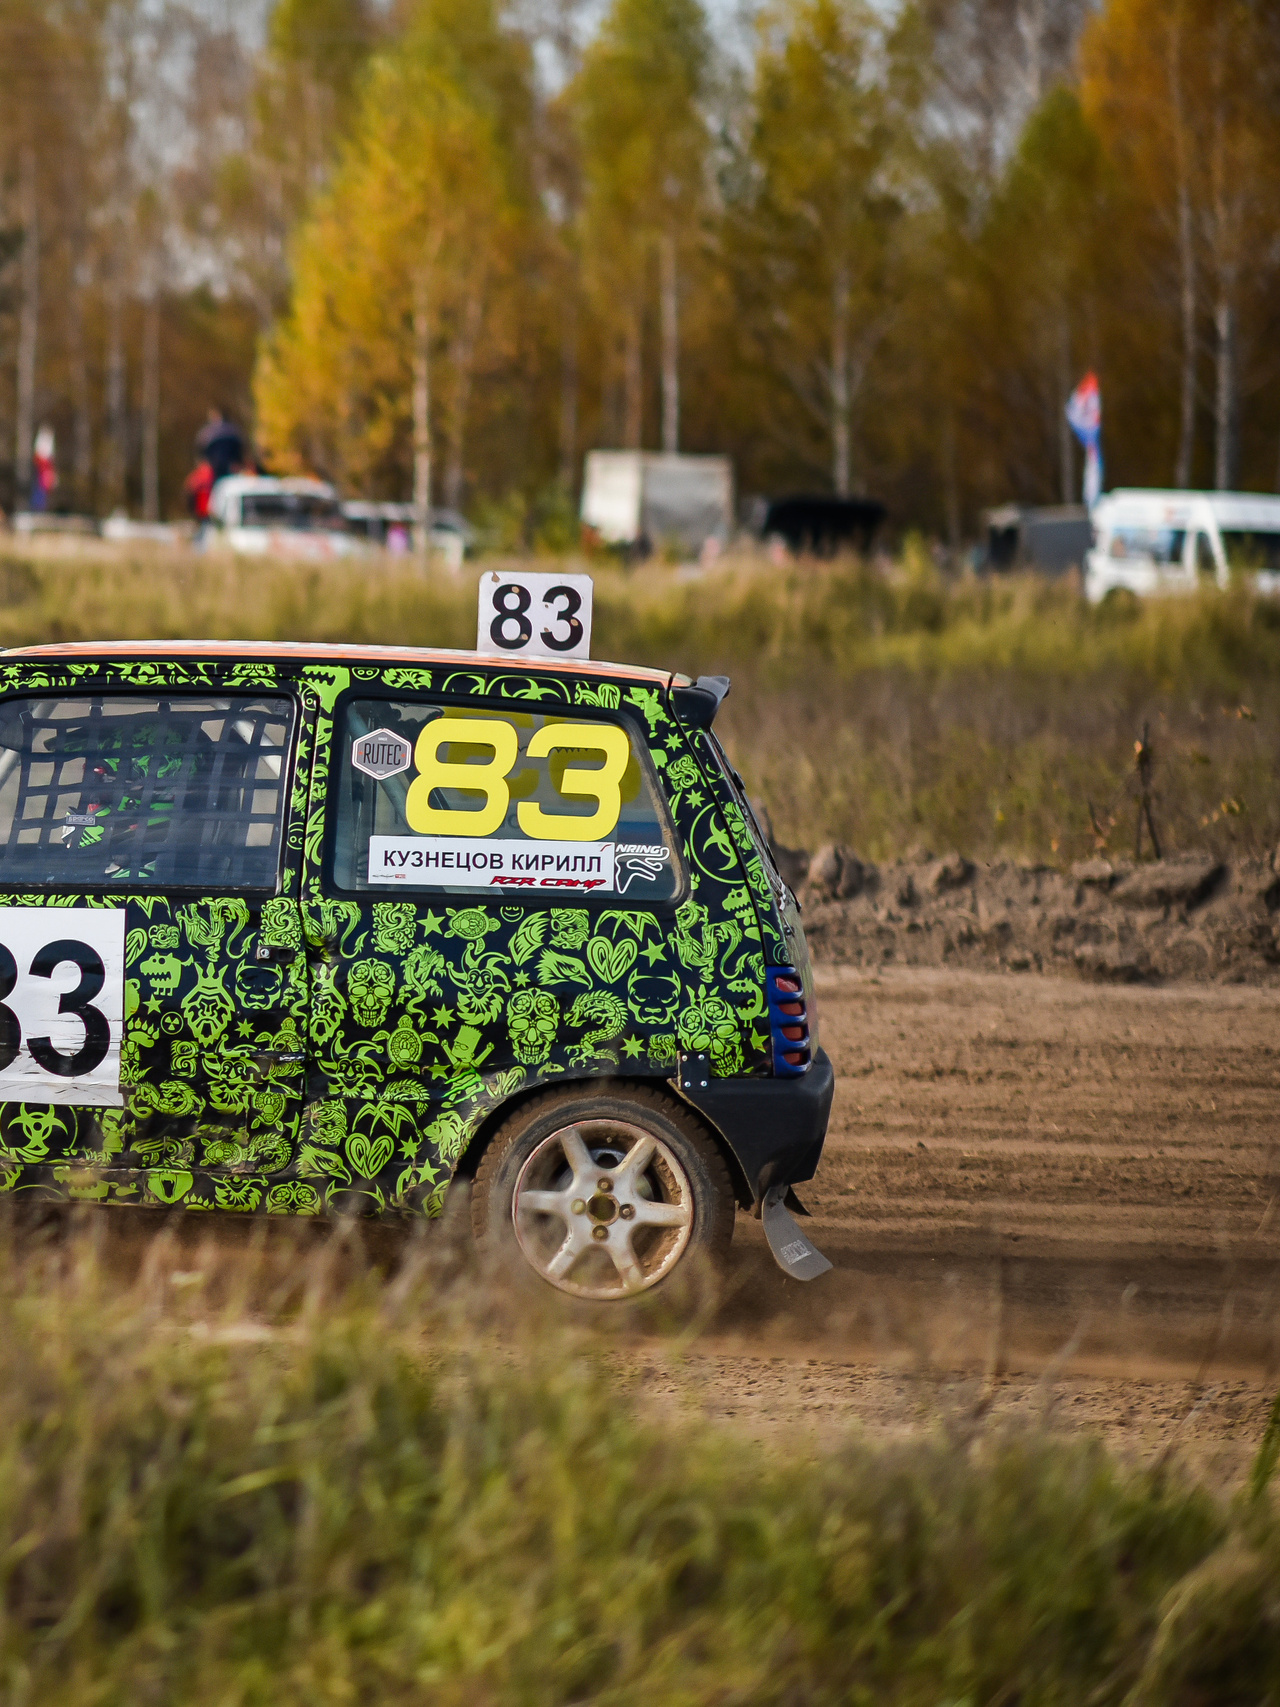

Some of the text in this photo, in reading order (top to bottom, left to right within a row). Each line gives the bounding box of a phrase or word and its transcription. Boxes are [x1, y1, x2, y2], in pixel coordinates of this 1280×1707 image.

[490, 584, 583, 651] 83
[363, 743, 401, 765] RUTEC
[406, 718, 629, 841] 83
[615, 844, 661, 854] NRING
[383, 850, 601, 872] КУЗНЕЦОВ КИРИЛЛ
[540, 878, 607, 889] CAMP
